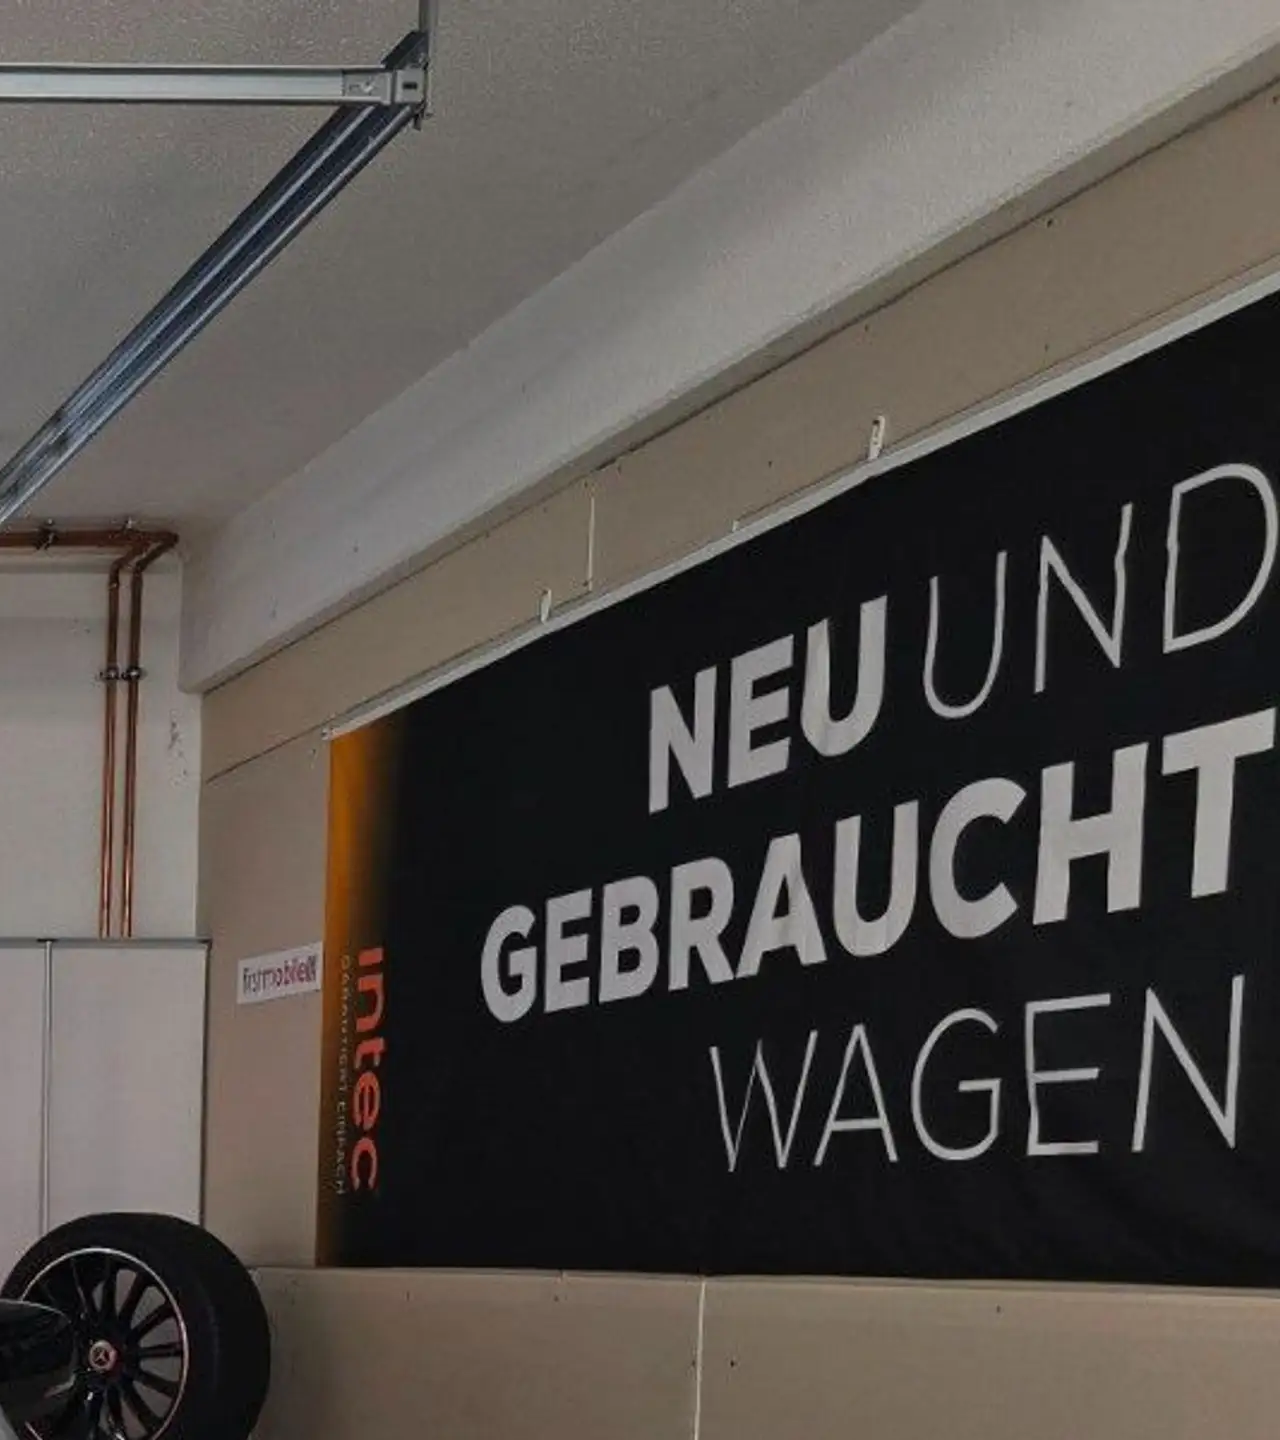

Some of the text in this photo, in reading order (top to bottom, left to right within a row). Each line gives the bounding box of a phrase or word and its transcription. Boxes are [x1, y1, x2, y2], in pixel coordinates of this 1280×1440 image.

[648, 462, 1279, 814] NEU UND
[480, 706, 1277, 1025] GEBRAUCHT
[709, 974, 1245, 1172] WAGEN
